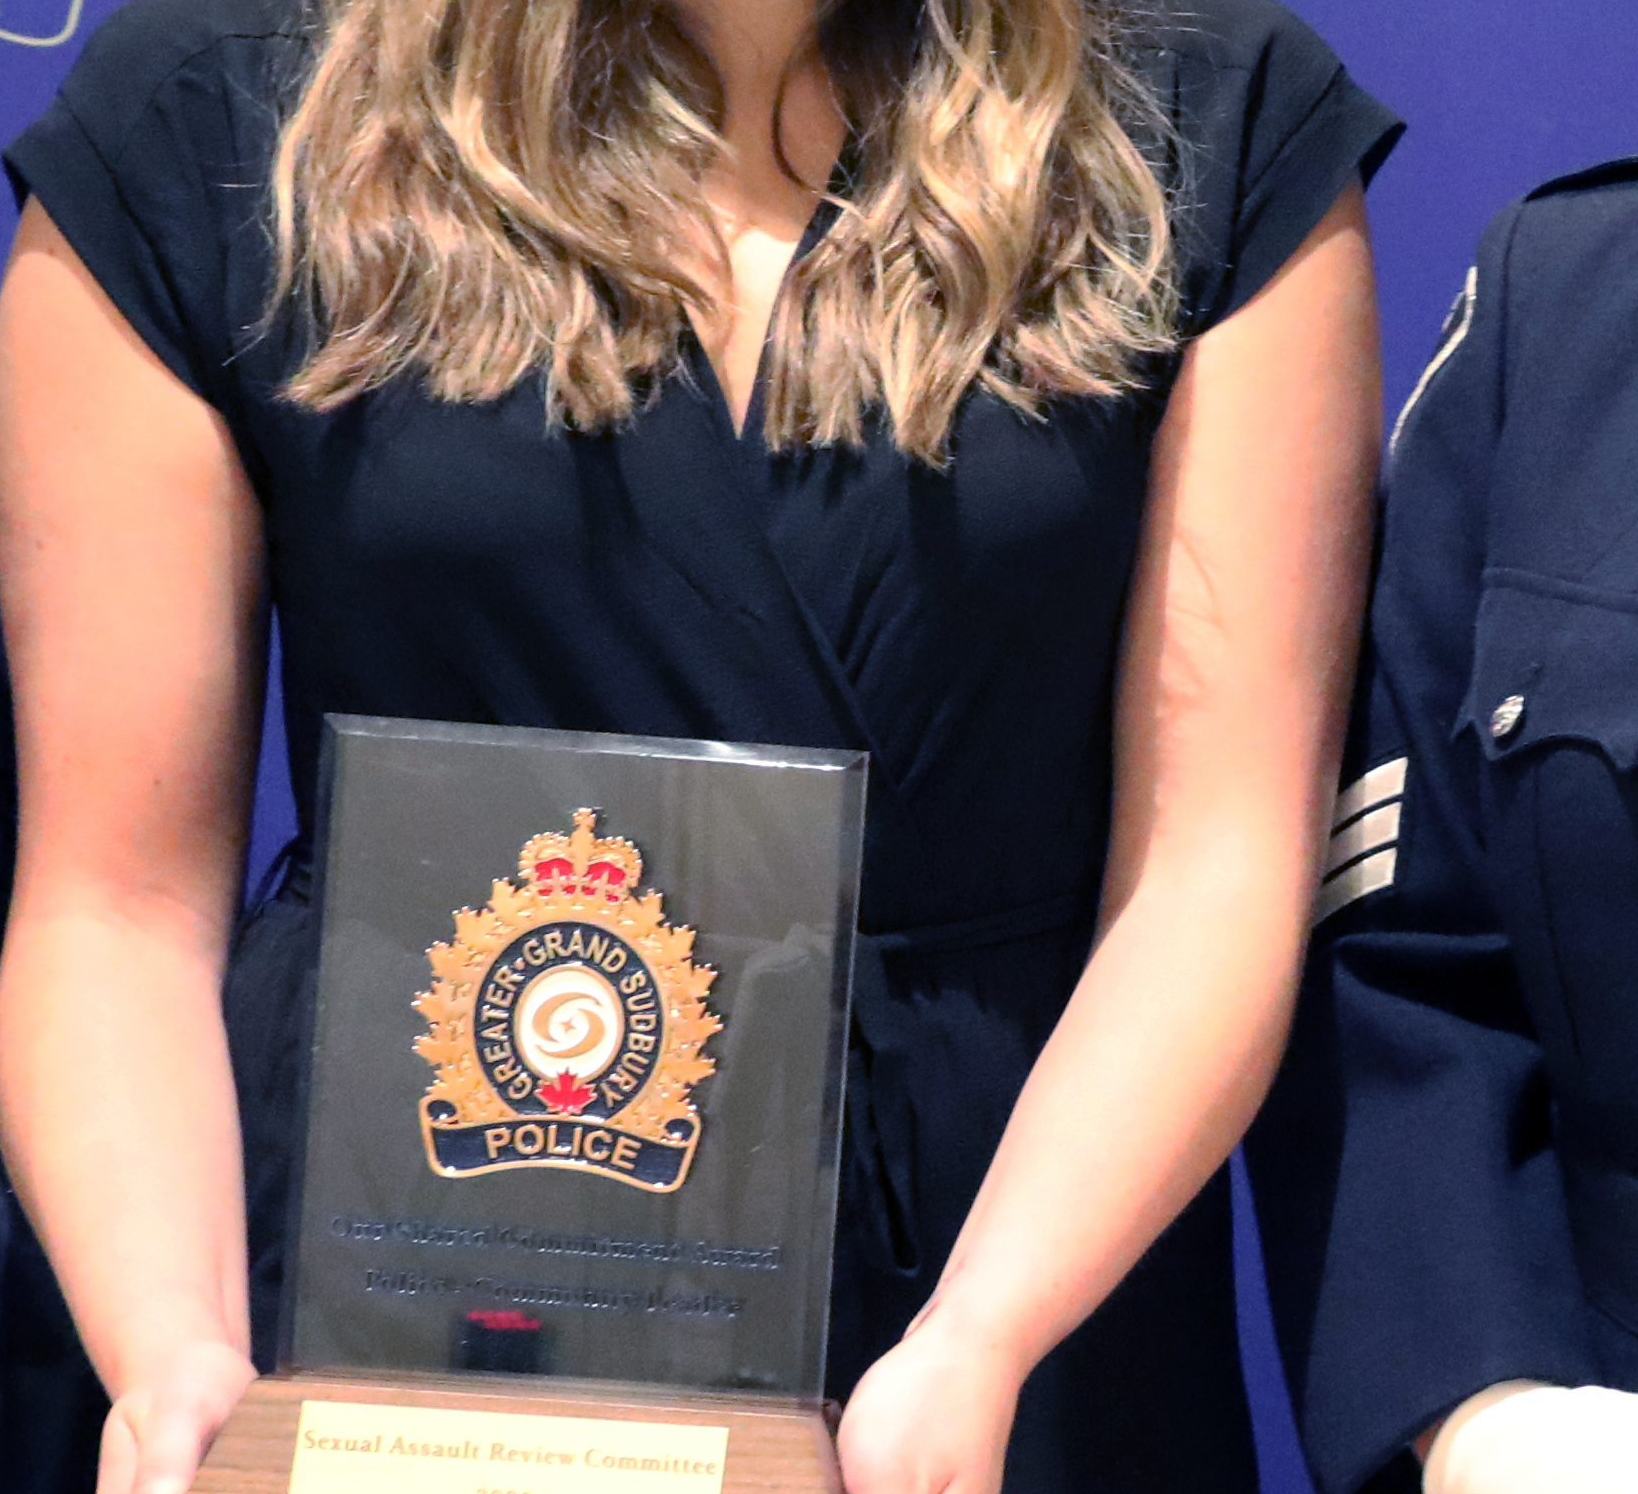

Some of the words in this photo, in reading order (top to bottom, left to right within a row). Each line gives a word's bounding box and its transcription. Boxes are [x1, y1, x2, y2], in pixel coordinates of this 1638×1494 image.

[522, 927, 627, 976] GRAND
[604, 970, 658, 1109] SUDBURY
[484, 1124, 644, 1171] POLICE
[303, 1429, 382, 1454] Sexual
[388, 1436, 480, 1461] Assault
[489, 1442, 576, 1466] Review
[583, 1448, 719, 1477] Committee
